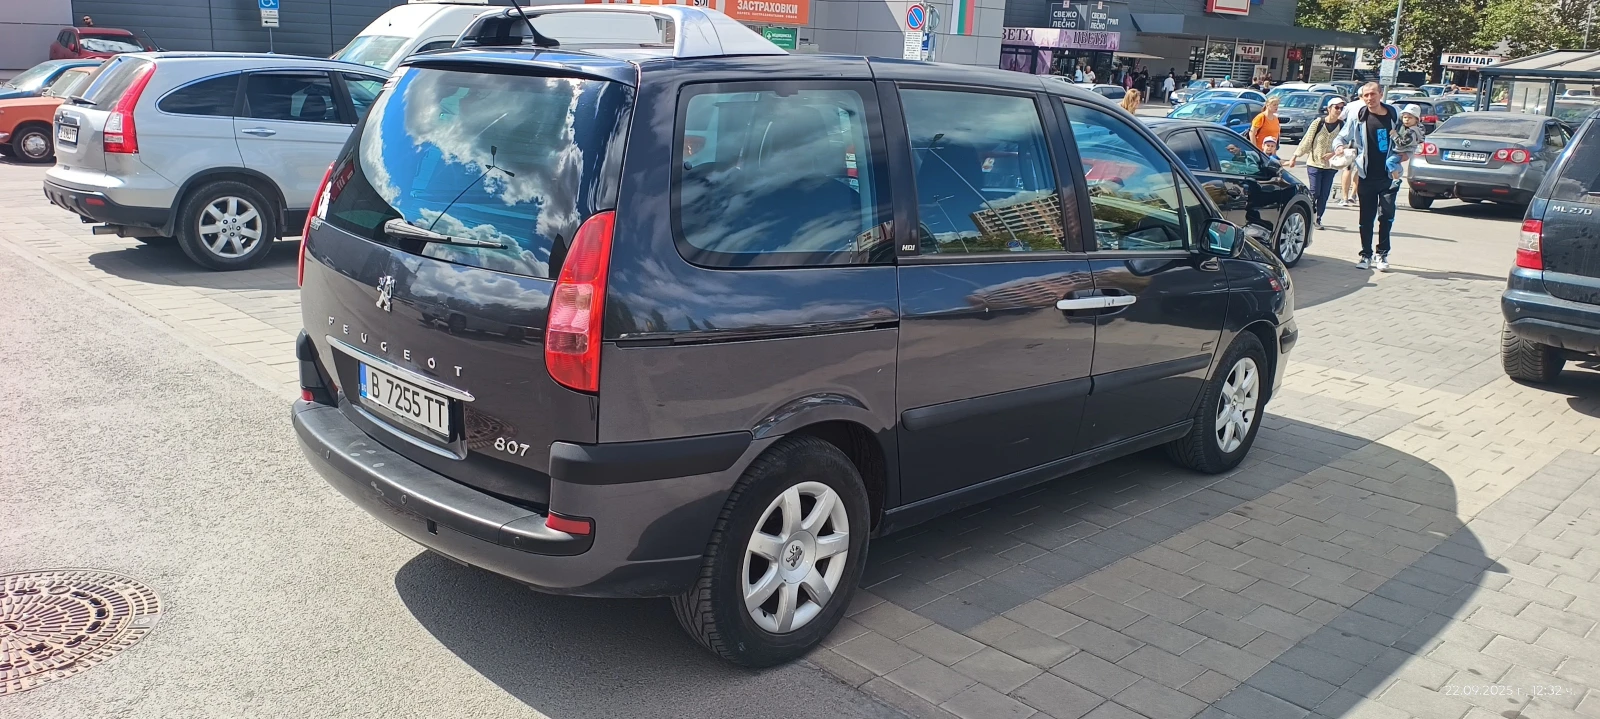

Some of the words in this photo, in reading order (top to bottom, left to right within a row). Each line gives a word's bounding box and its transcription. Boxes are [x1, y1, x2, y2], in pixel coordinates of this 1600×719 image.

[737, 0, 798, 14] ЗАСТРАХОВКИ
[1053, 10, 1077, 18] СВЕЖО
[1091, 12, 1107, 20] СВЕЖО
[1052, 20, 1076, 28] ЛЕСНО
[1090, 22, 1106, 30] ЛЕСНО
[1073, 31, 1107, 46] ЦВЕТЯ
[1448, 55, 1493, 65] КЛЮЧАР
[1552, 205, 1567, 213] ML
[1569, 206, 1593, 216] 270
[328, 316, 463, 377] PEUGEOT
[371, 371, 380, 399] B
[386, 378, 421, 418] 7255
[424, 397, 446, 428] TT
[494, 437, 530, 457] 807
